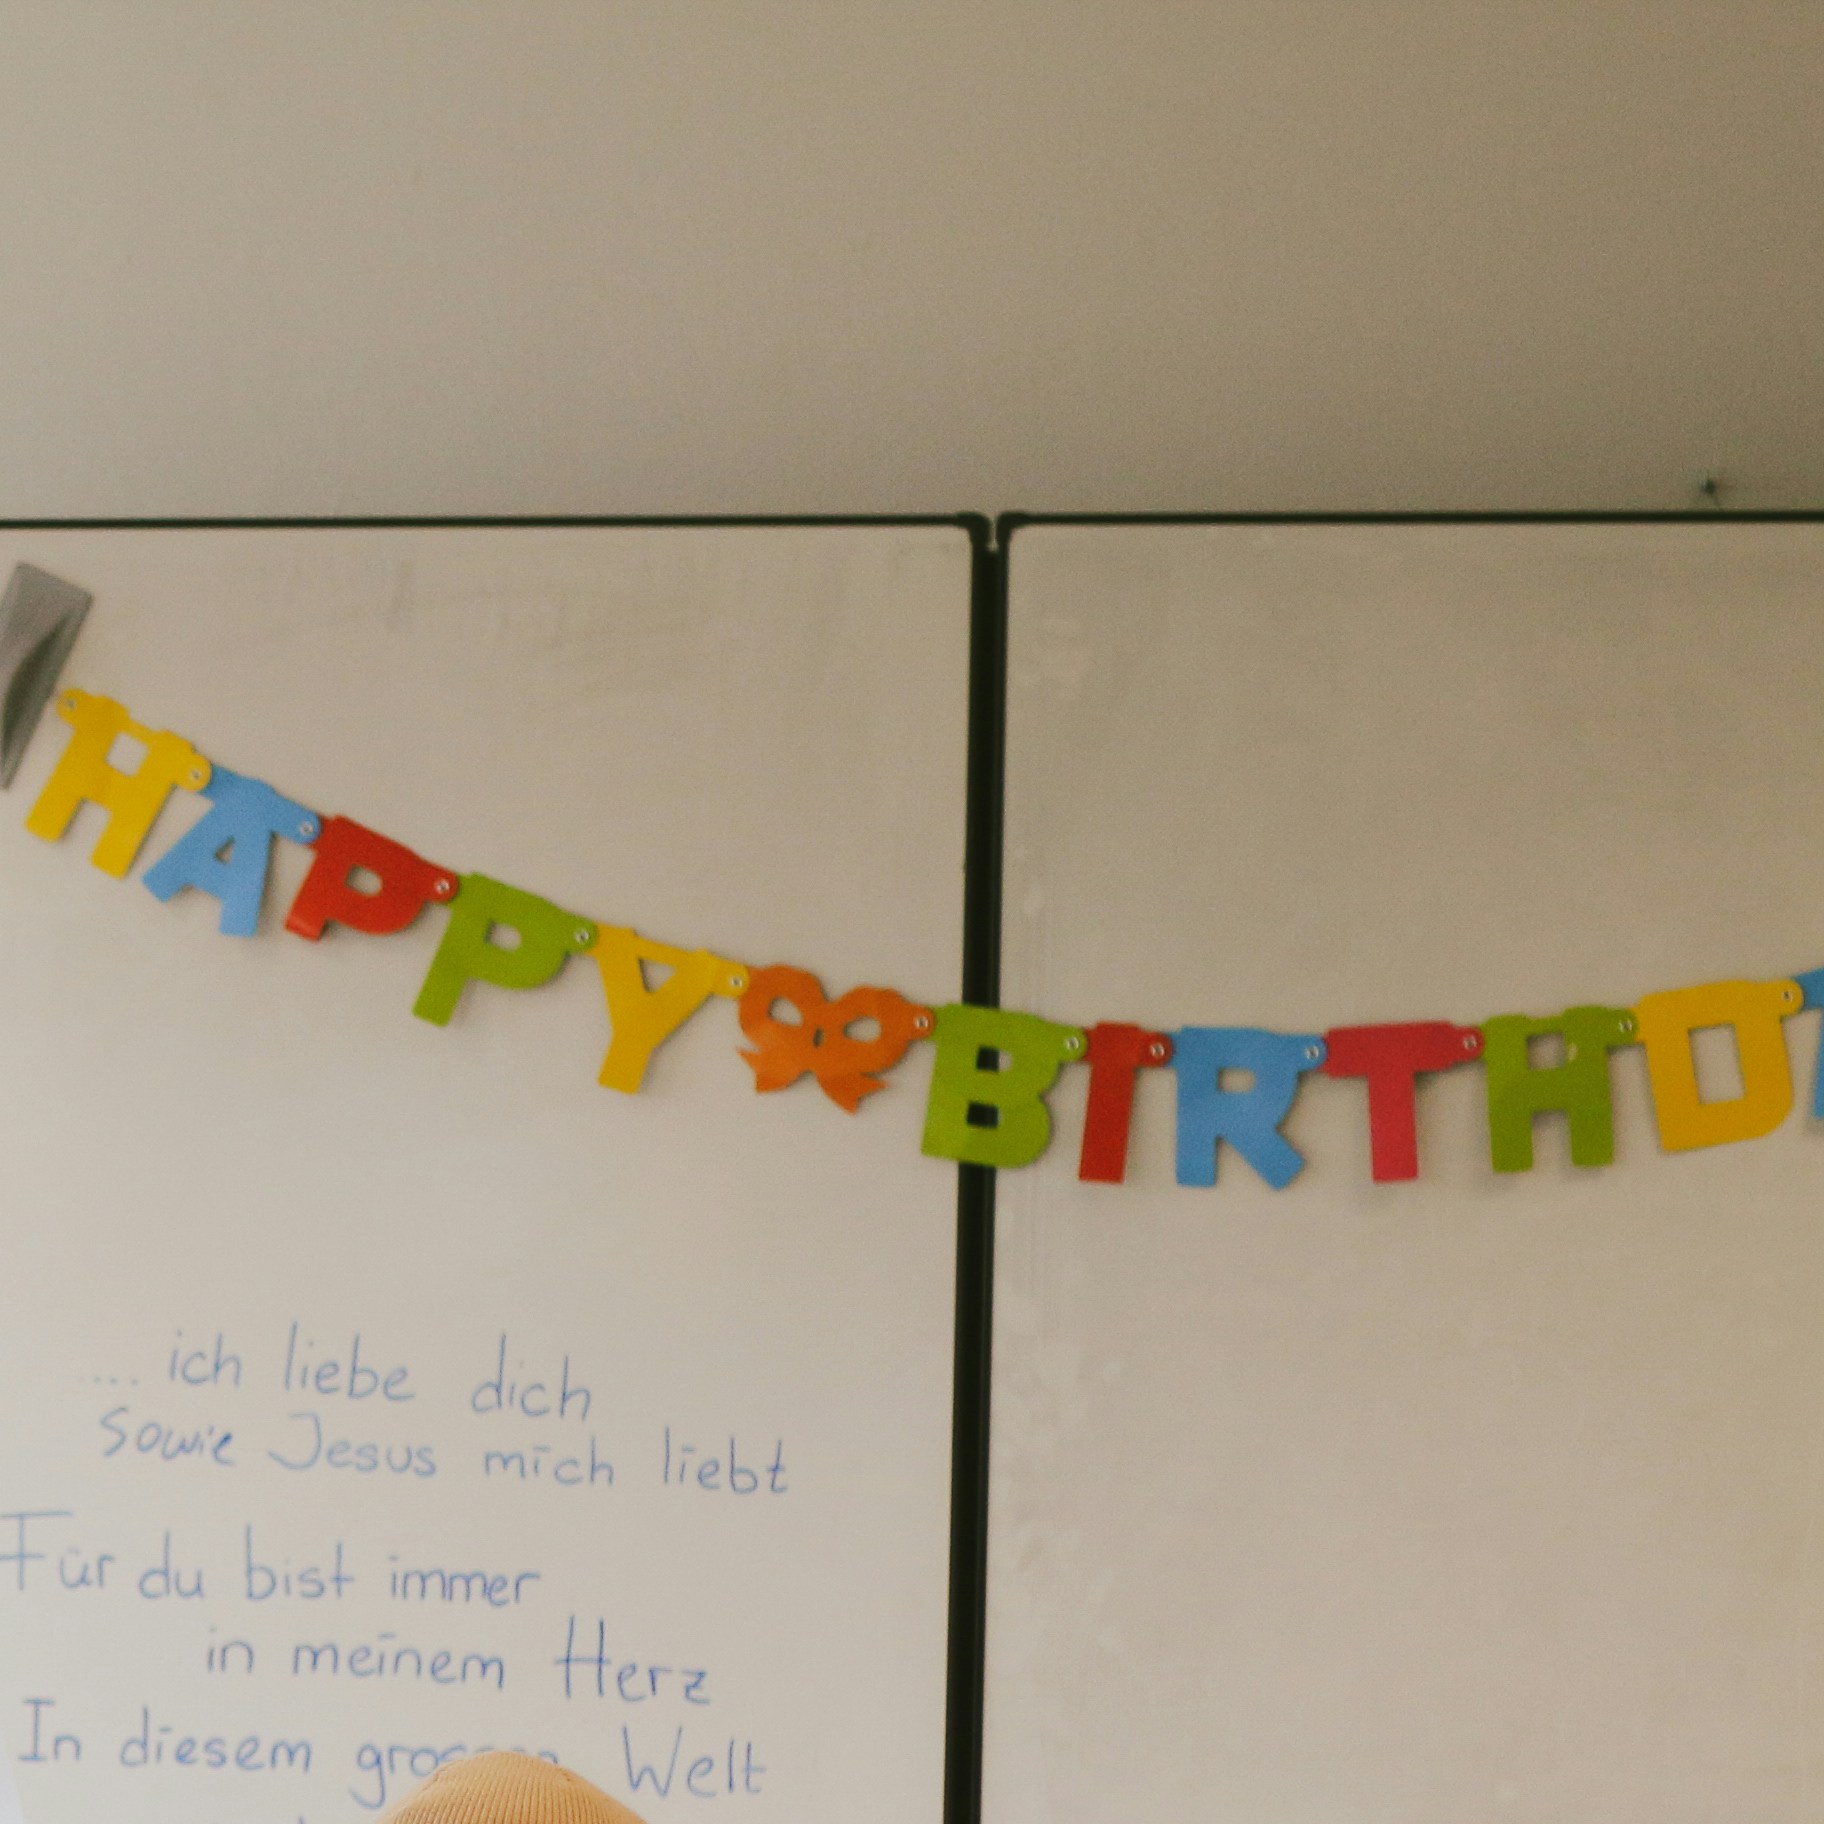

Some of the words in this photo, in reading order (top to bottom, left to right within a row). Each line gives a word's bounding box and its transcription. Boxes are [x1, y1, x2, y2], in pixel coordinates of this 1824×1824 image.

[25, 688, 749, 1096] HAPPY
[921, 967, 1824, 1191] BIRTHD
[167, 1328, 244, 1388] ich
[282, 1320, 417, 1402] liebe
[470, 1332, 594, 1421] dich
[267, 1410, 440, 1478] Jesus
[483, 1434, 616, 1488] mich
[662, 1425, 790, 1495] liebt
[137, 1531, 207, 1601] du
[244, 1523, 355, 1602] bist
[388, 1554, 544, 1608] immer
[205, 1626, 256, 1674] in
[291, 1632, 506, 1691] meinem
[554, 1614, 711, 1706] Herz
[19, 1697, 82, 1764] In
[118, 1705, 314, 1773] diesem
[620, 1724, 768, 1800] Welt
